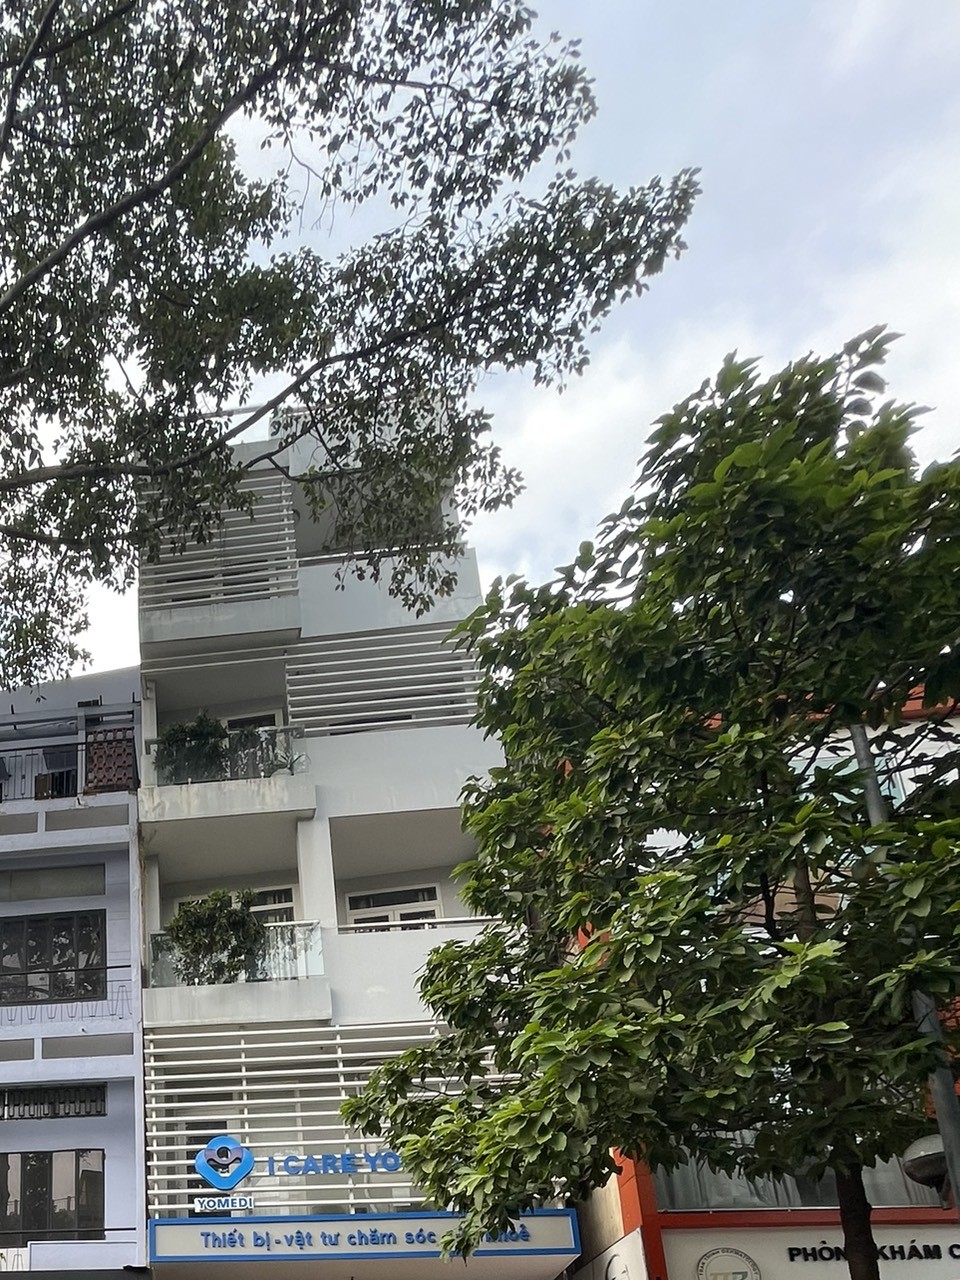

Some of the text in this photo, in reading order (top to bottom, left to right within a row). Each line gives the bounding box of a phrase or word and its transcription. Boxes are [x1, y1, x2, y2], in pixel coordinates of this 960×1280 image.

[283, 1154, 357, 1174] CARE
[365, 1152, 400, 1172] YO
[197, 1198, 253, 1209] YOMEDI
[200, 1228, 436, 1250] Thiết bị vật tư chăm sóc
[788, 1241, 848, 1262] PHÒN
